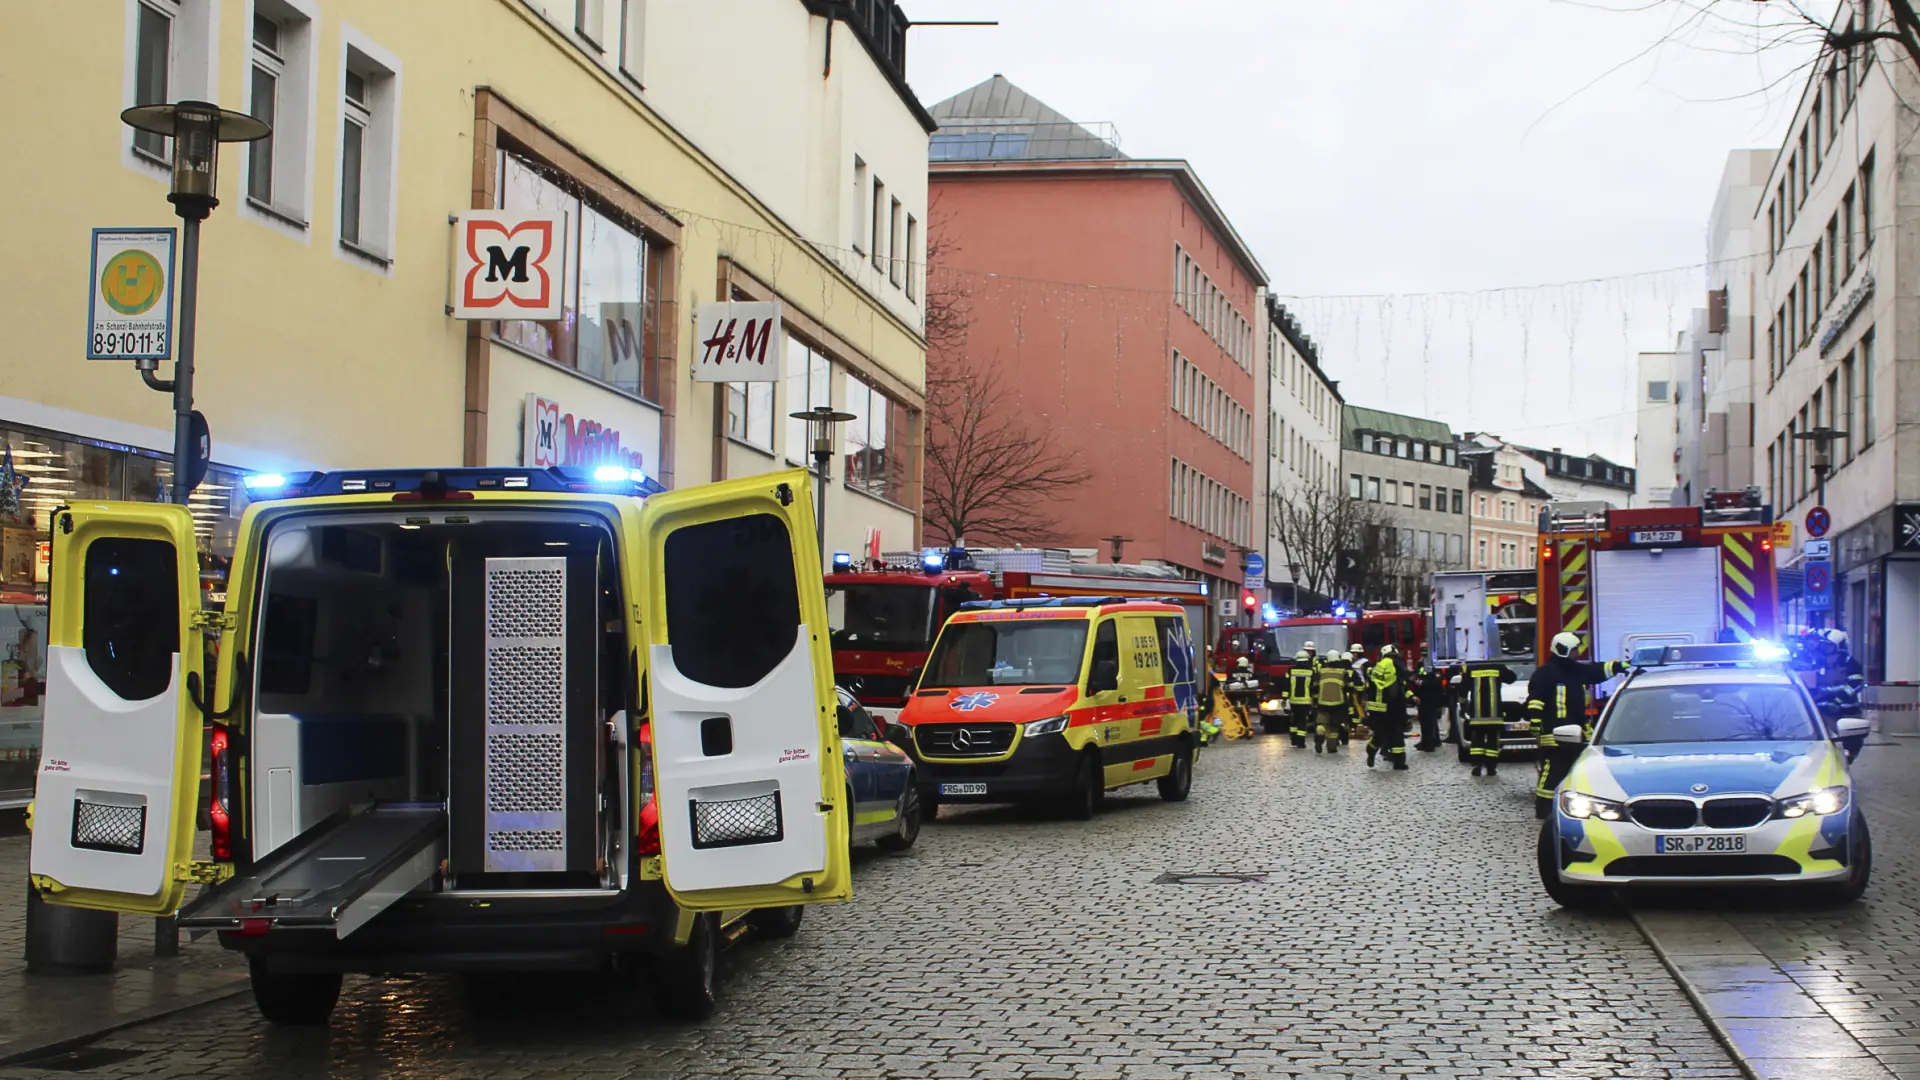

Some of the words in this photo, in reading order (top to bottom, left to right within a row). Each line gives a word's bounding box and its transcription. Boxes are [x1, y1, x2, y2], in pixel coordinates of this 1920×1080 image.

[484, 245, 531, 283] M
[118, 264, 147, 299] H
[95, 322, 105, 331] Am
[702, 317, 773, 366] H&M
[1640, 532, 1652, 541] PA
[1658, 531, 1676, 541] 237
[1806, 595, 1830, 605] TAXI
[1133, 651, 1143, 668] 19
[1144, 651, 1158, 667] 218
[942, 784, 958, 793] FRG
[963, 784, 975, 793] DD
[975, 784, 986, 793] 99
[1665, 837, 1685, 851] SR
[1694, 836, 1704, 851] P
[1706, 836, 1744, 851] 2818
